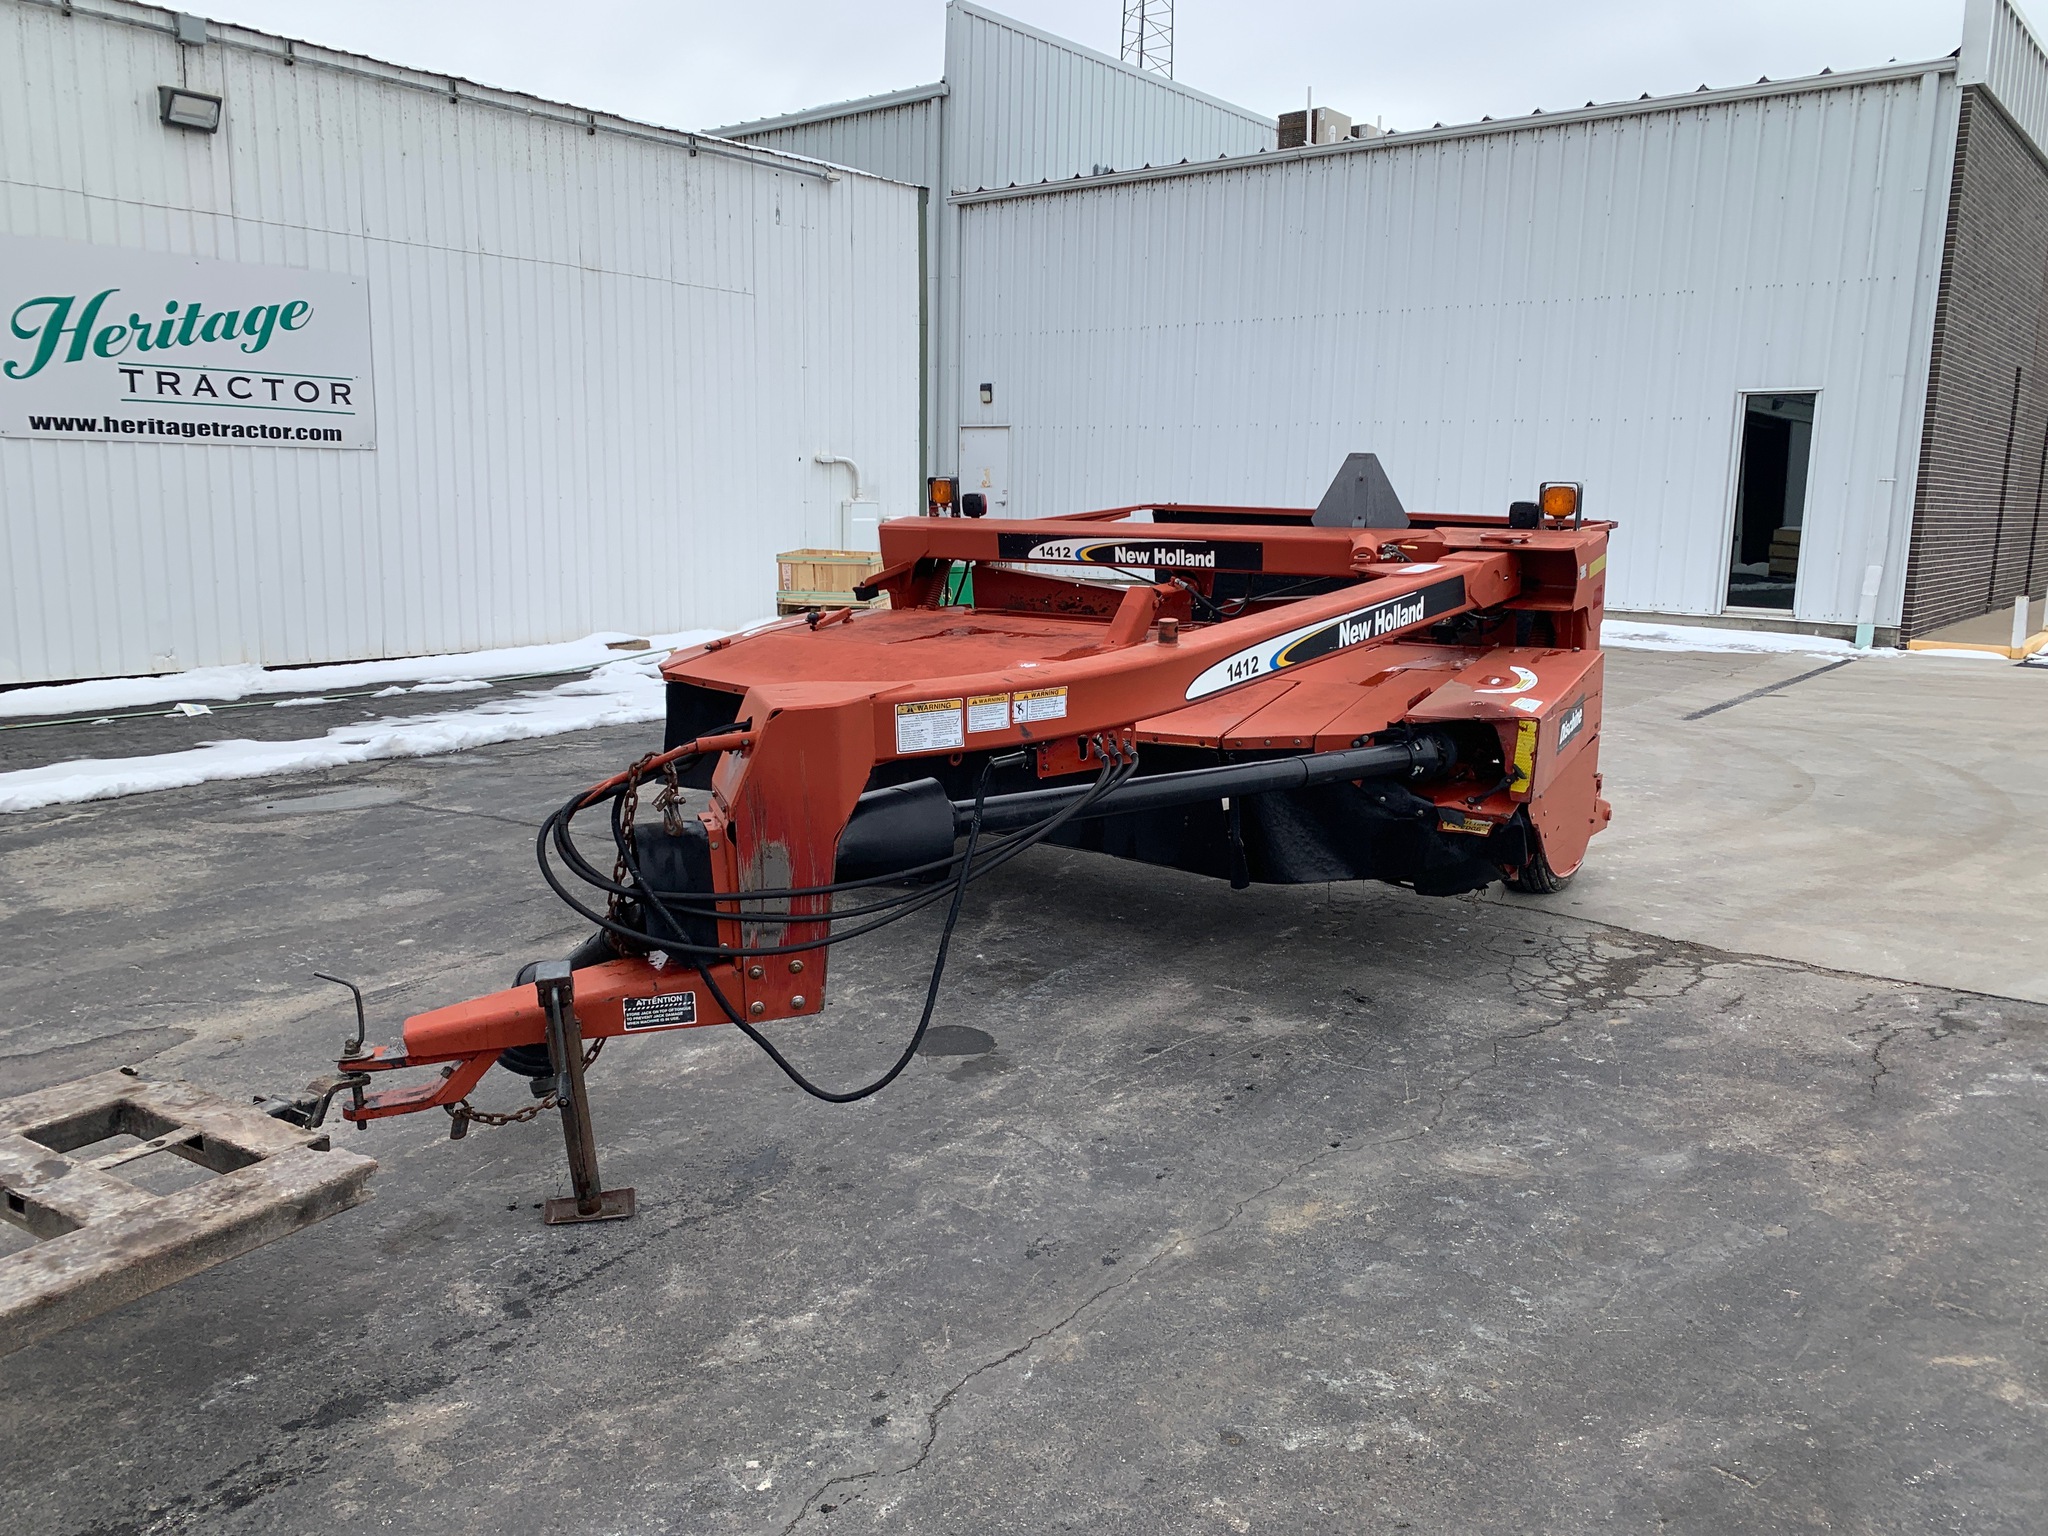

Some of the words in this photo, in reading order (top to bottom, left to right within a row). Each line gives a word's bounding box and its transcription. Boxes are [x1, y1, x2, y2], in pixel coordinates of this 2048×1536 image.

[2, 288, 314, 380] Heritage
[118, 367, 353, 405] TRACTOR
[28, 415, 343, 443] www.heritagetractor.com
[1038, 545, 1071, 559] 1412
[1114, 546, 1151, 565] New
[1154, 547, 1216, 568] Holland
[1226, 655, 1259, 682] 1412
[1338, 618, 1372, 649] New
[1374, 596, 1425, 636] Holland
[978, 696, 1005, 704] WARNING
[1031, 689, 1060, 698] WARNING
[916, 702, 952, 712] WARNING
[636, 995, 683, 1006] ATTENTION
